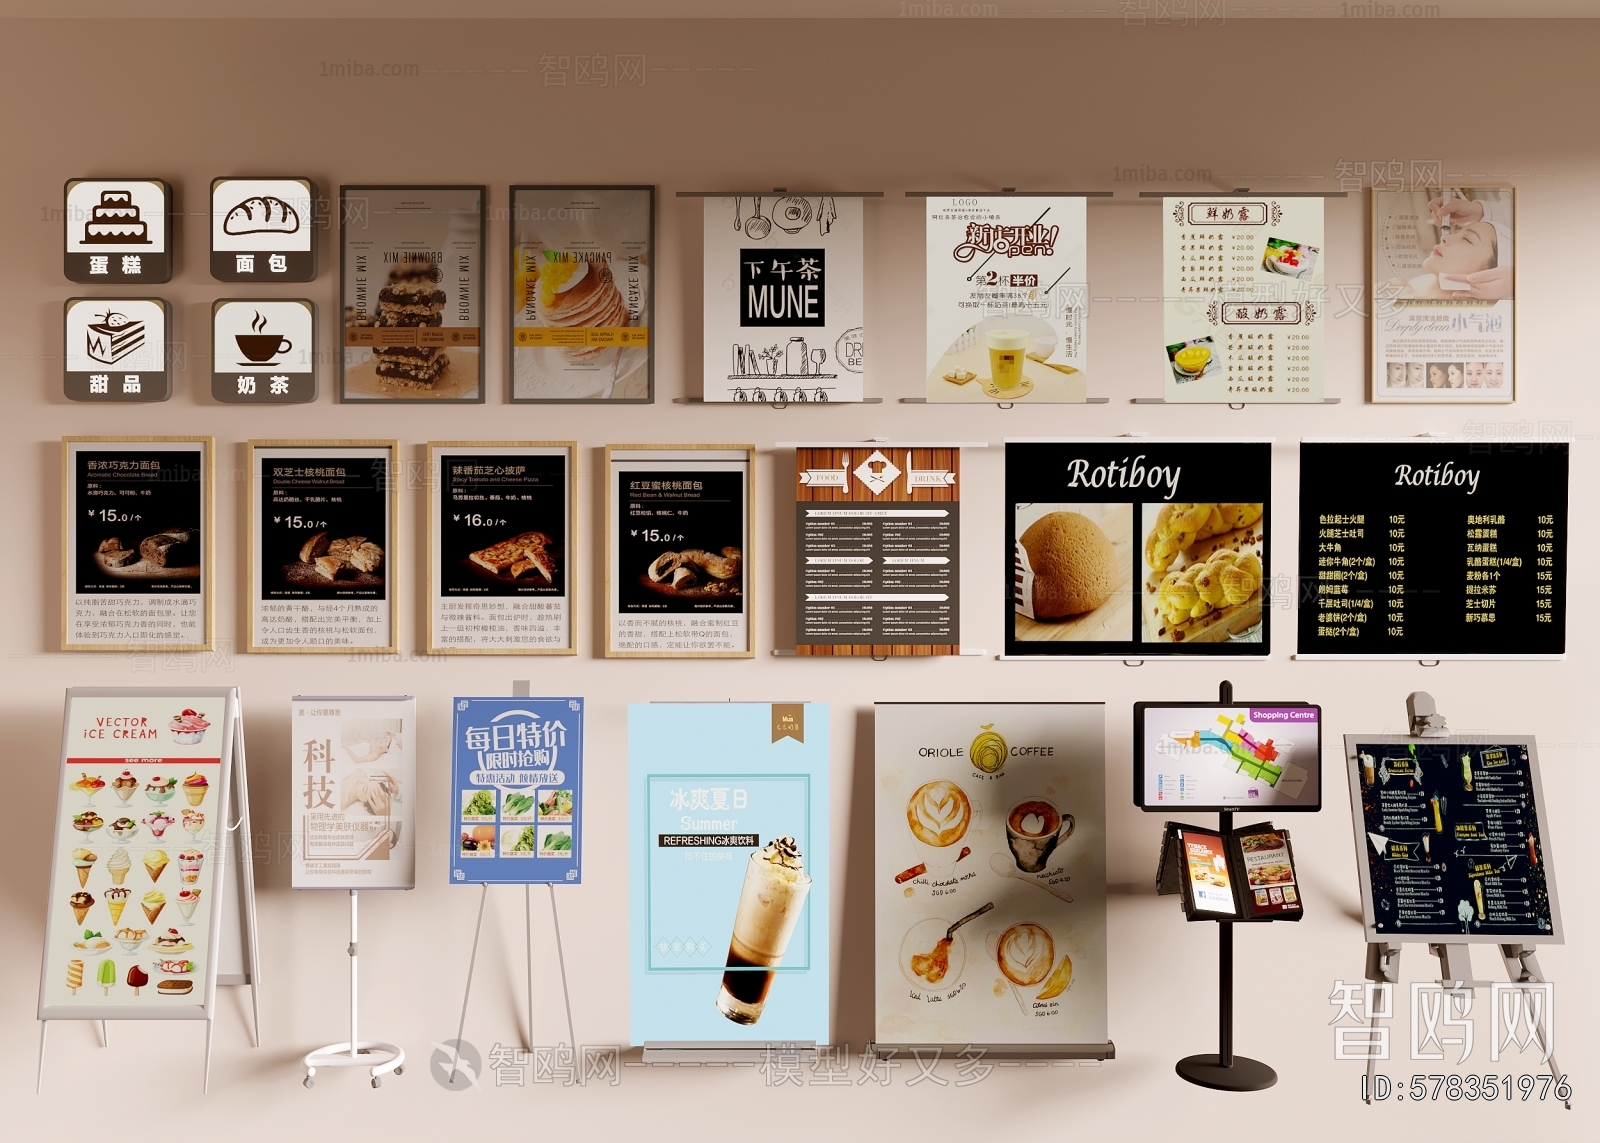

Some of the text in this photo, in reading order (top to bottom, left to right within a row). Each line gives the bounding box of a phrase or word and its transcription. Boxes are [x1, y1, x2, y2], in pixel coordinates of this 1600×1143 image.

[952, 198, 978, 207] LOGO
[1206, 207, 1250, 221] 鲜奶露
[89, 255, 142, 275] 蛋糕
[235, 253, 288, 274] 面包
[743, 257, 822, 282] 下午茶
[748, 284, 819, 319] MUNE
[89, 374, 142, 394] 甜品
[236, 375, 290, 395] 奶茶
[87, 460, 161, 470] 香浓巧克力面包
[452, 465, 526, 475] 辣番茄芝心披萨
[273, 467, 346, 477] 双芝士核桃面包
[1067, 454, 1181, 500] Rotiboy
[816, 474, 839, 482] FOOD
[914, 474, 942, 482] DRINK
[1394, 461, 1481, 495] Rotiboy
[629, 481, 703, 490] 红豆蜜核桃面包
[99, 509, 128, 522] 15.0
[464, 513, 493, 527] 16.0
[1389, 514, 1405, 524] 10元
[1537, 515, 1554, 524] 10元
[285, 515, 314, 528] 15.0
[641, 529, 671, 542] 15.0
[1389, 529, 1405, 538] 10元
[1537, 529, 1553, 538] 10元
[1318, 542, 1405, 552] 大牛角 10元
[1537, 543, 1553, 552] 10元
[1388, 556, 1404, 566] 10元
[1537, 557, 1552, 566] 10元
[1388, 571, 1404, 580] 10元
[1536, 571, 1552, 580] 15元
[1388, 585, 1404, 594] 10元
[1466, 585, 1552, 594] 提拉米苏 15元
[1388, 599, 1404, 608] 10元
[1466, 599, 1552, 608] 芝士切片 15元
[1388, 613, 1404, 622] 10元
[1536, 613, 1552, 622] 15元
[1388, 627, 1403, 636] 10元
[1253, 711, 1315, 720] Shopping Centre
[96, 717, 148, 727] VECTOR
[113, 729, 158, 739] CREAM
[465, 720, 568, 752] 每日特价
[918, 746, 1054, 758] ORIOLE COFFEE
[486, 748, 550, 770] 限时抢购
[302, 738, 336, 810] 科技
[476, 773, 559, 784] 特惠活动 倾情放送
[669, 787, 748, 811] 冰爽夏日
[680, 816, 738, 831] Summer
[1246, 852, 1284, 862] RESTAURANT
